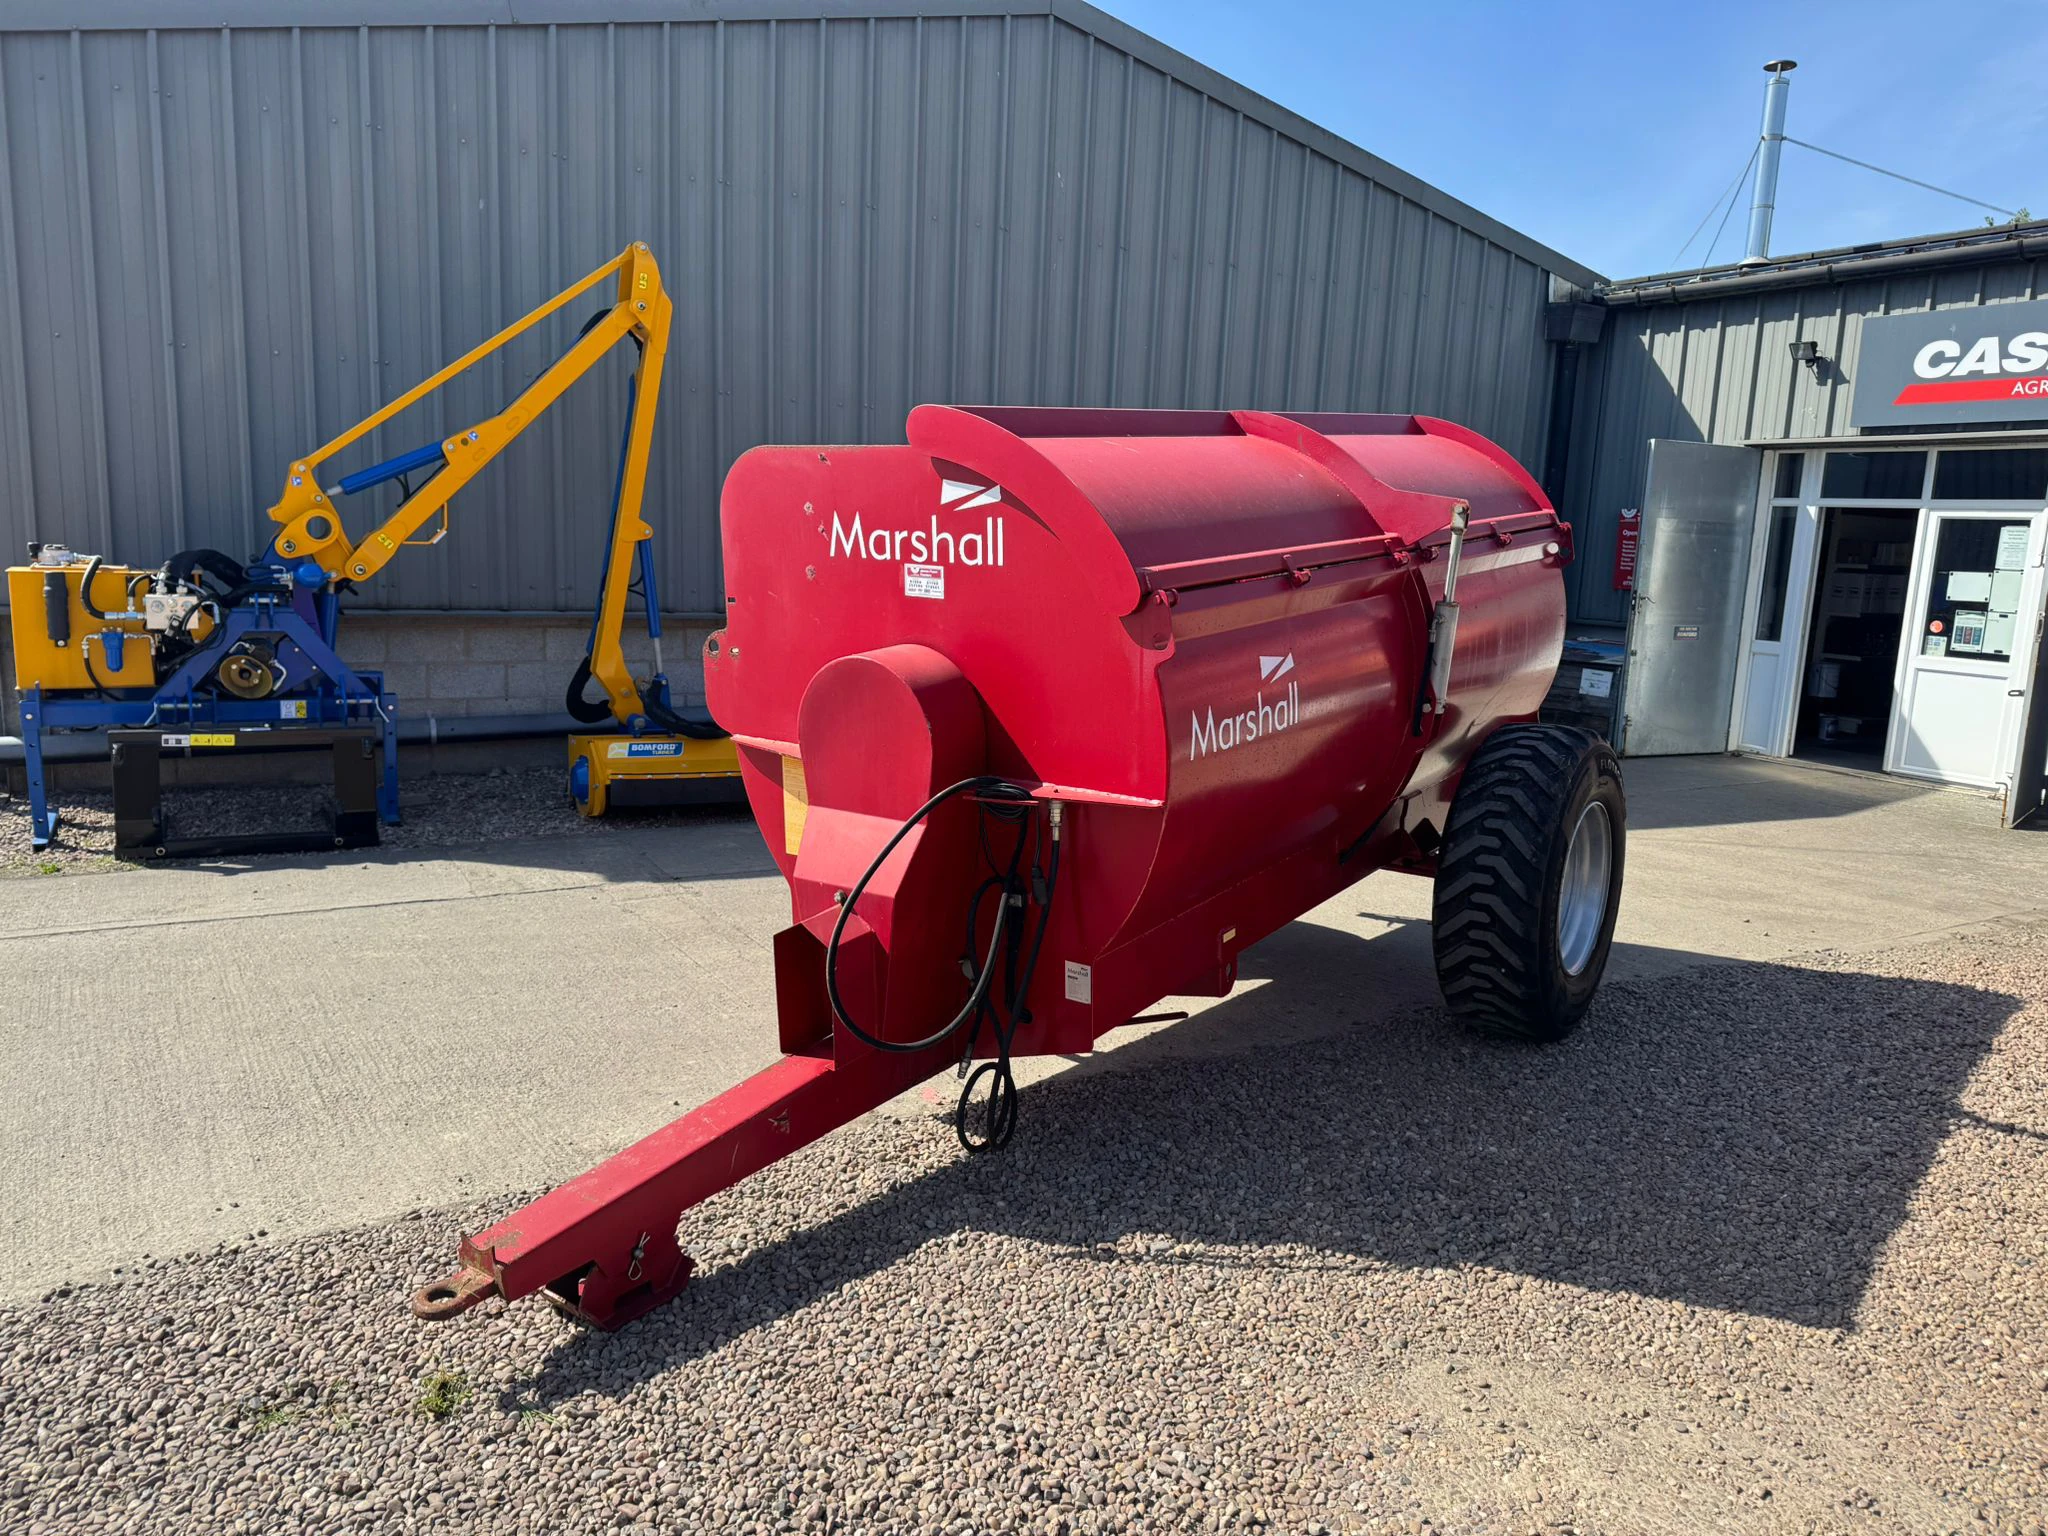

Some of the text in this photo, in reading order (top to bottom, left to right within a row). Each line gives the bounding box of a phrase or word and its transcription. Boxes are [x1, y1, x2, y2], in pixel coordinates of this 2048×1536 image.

[1913, 331, 2048, 379] CAS
[829, 510, 1004, 567] Marshall
[631, 743, 676, 751] BOMFORD
[1190, 681, 1298, 761] Marshall
